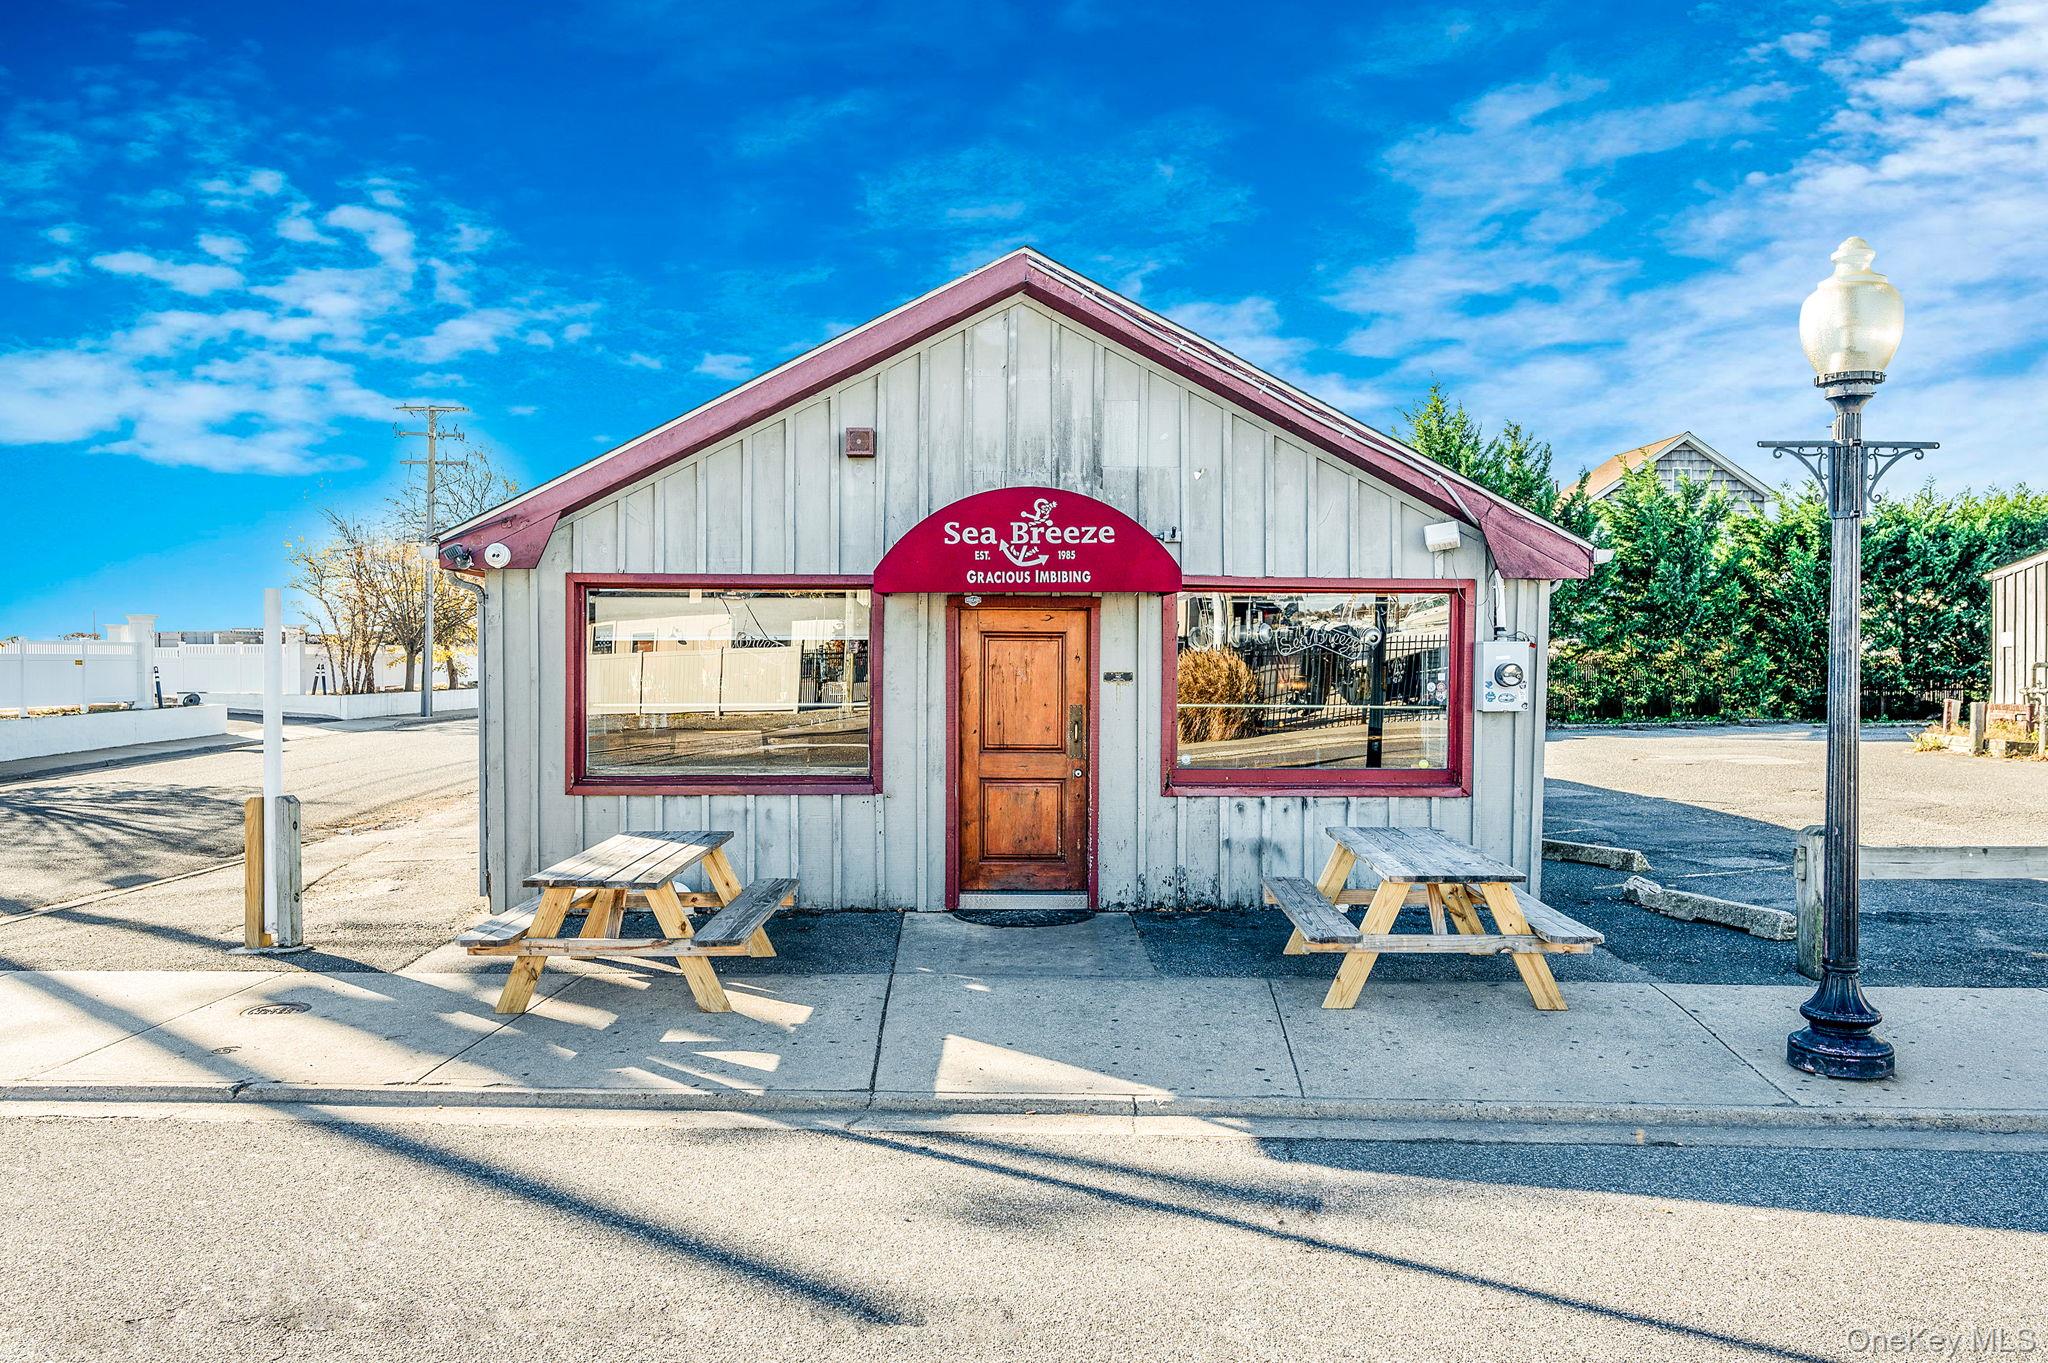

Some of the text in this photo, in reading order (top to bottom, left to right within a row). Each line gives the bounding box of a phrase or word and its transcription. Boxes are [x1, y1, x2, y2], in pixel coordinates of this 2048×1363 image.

[944, 521, 1115, 544] Sea Breeze
[974, 550, 1076, 561] EST. 1985
[966, 569, 1091, 584] GRACIOUS IMBIBING
